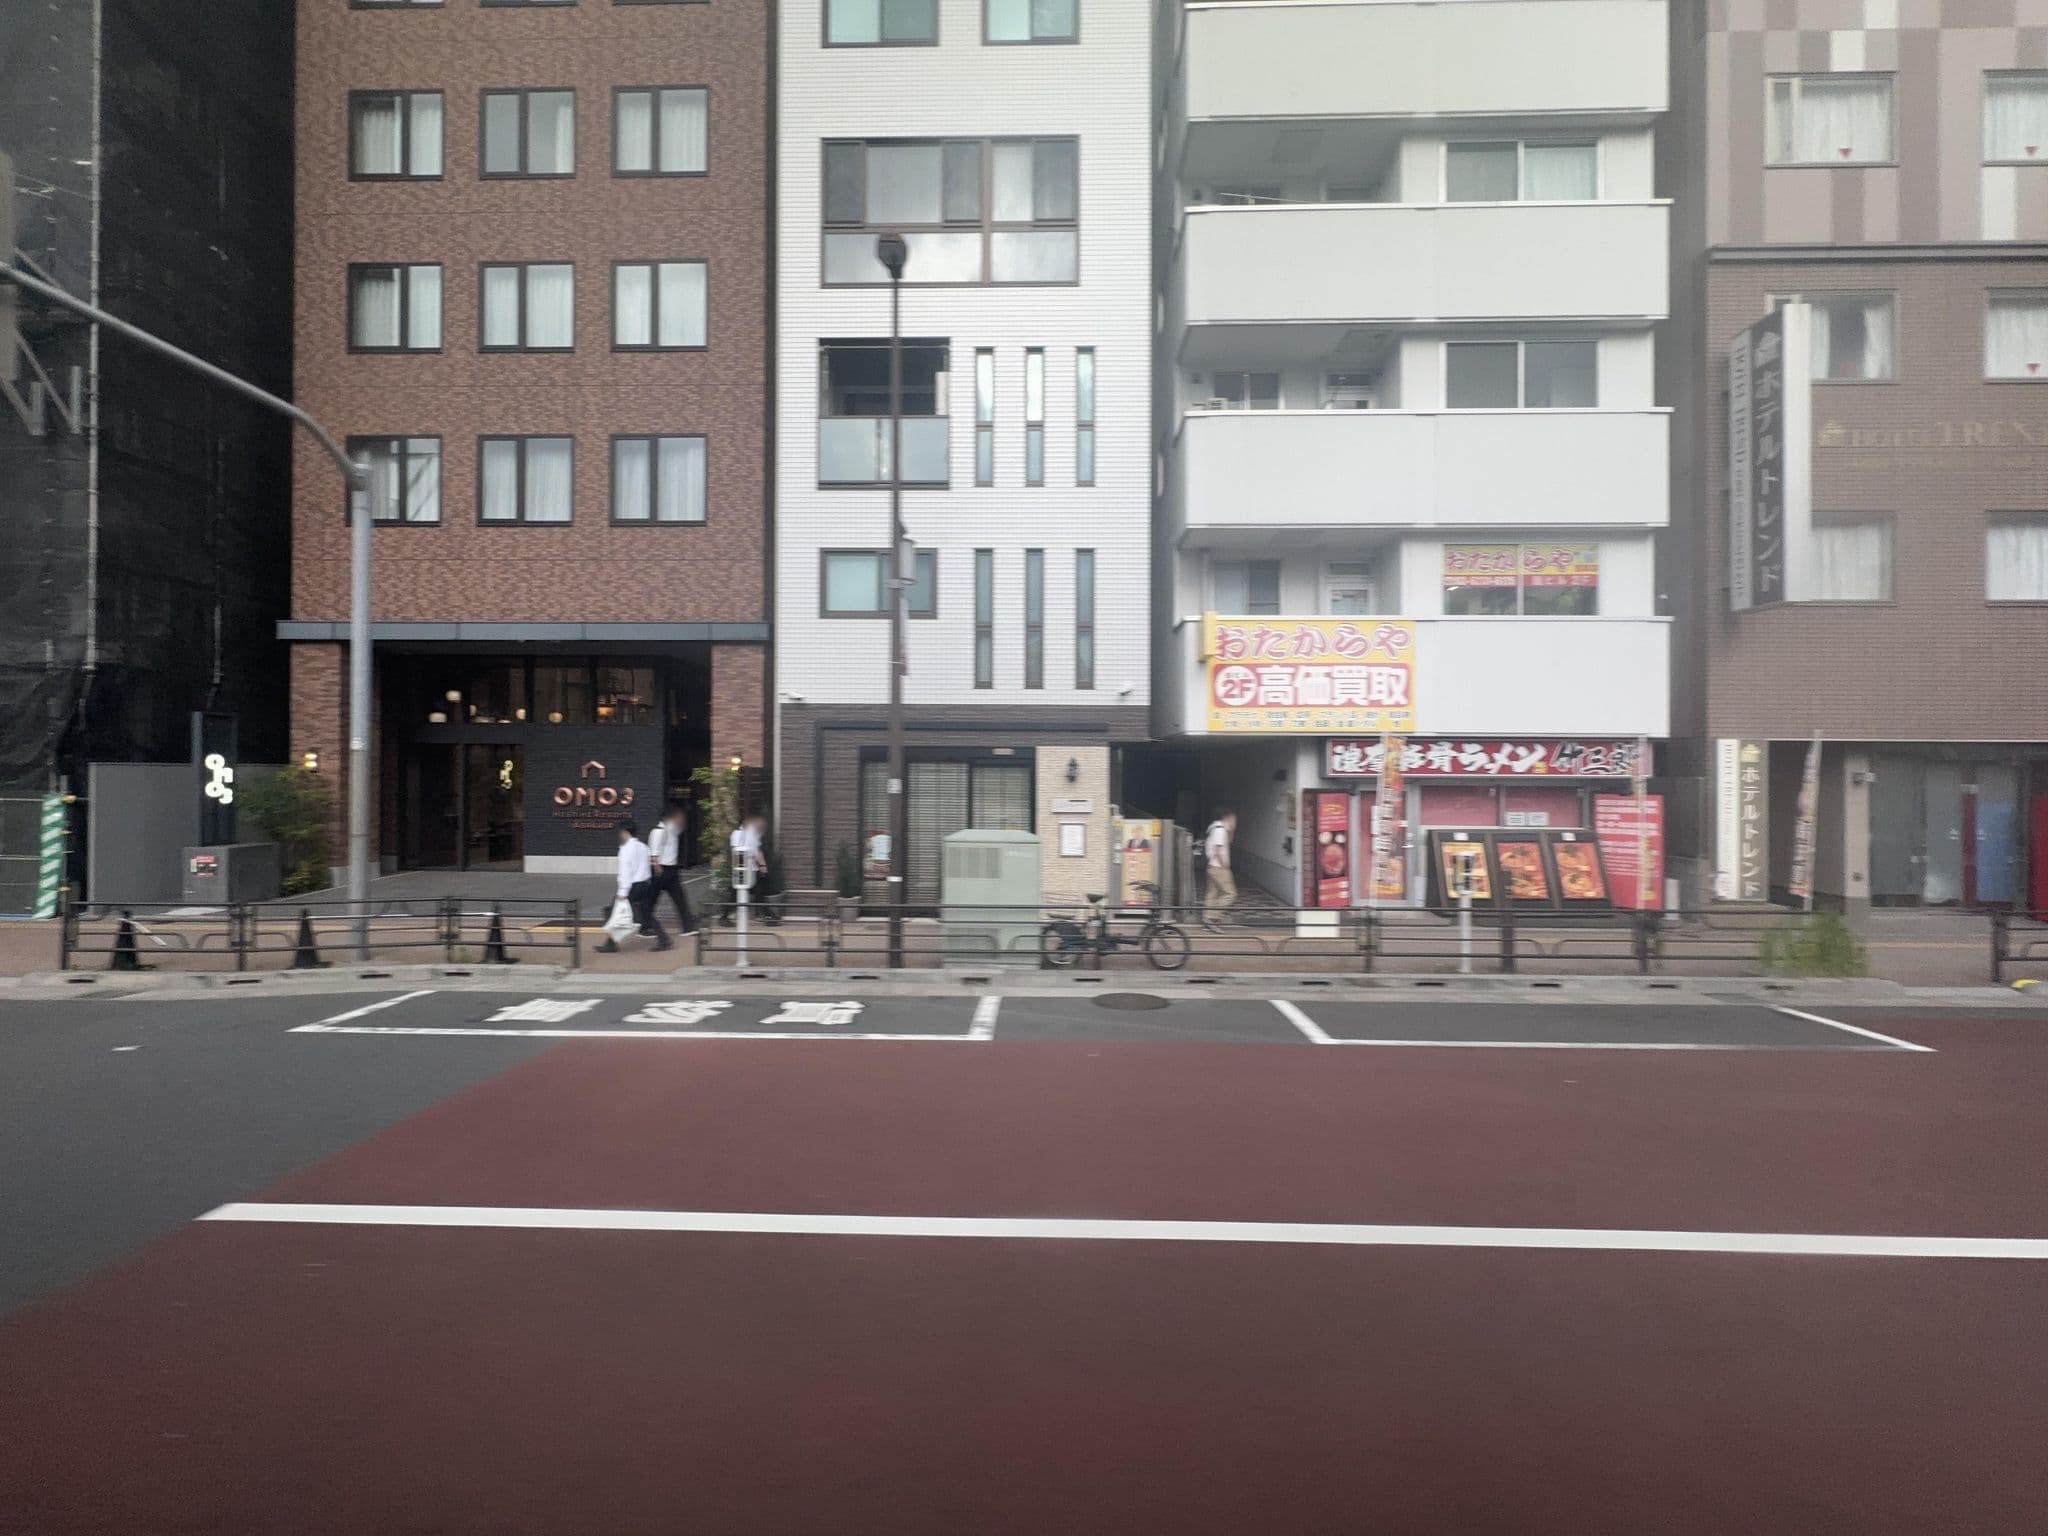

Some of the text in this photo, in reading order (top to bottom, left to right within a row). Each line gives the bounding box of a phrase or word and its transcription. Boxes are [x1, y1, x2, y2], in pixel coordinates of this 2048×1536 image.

[1215, 624, 1410, 660] おたからや
[1222, 679, 1253, 698] 2F
[1256, 665, 1409, 706] 高価買取
[553, 786, 634, 806] OMO3
[1741, 767, 1761, 897] ホテルトレンド
